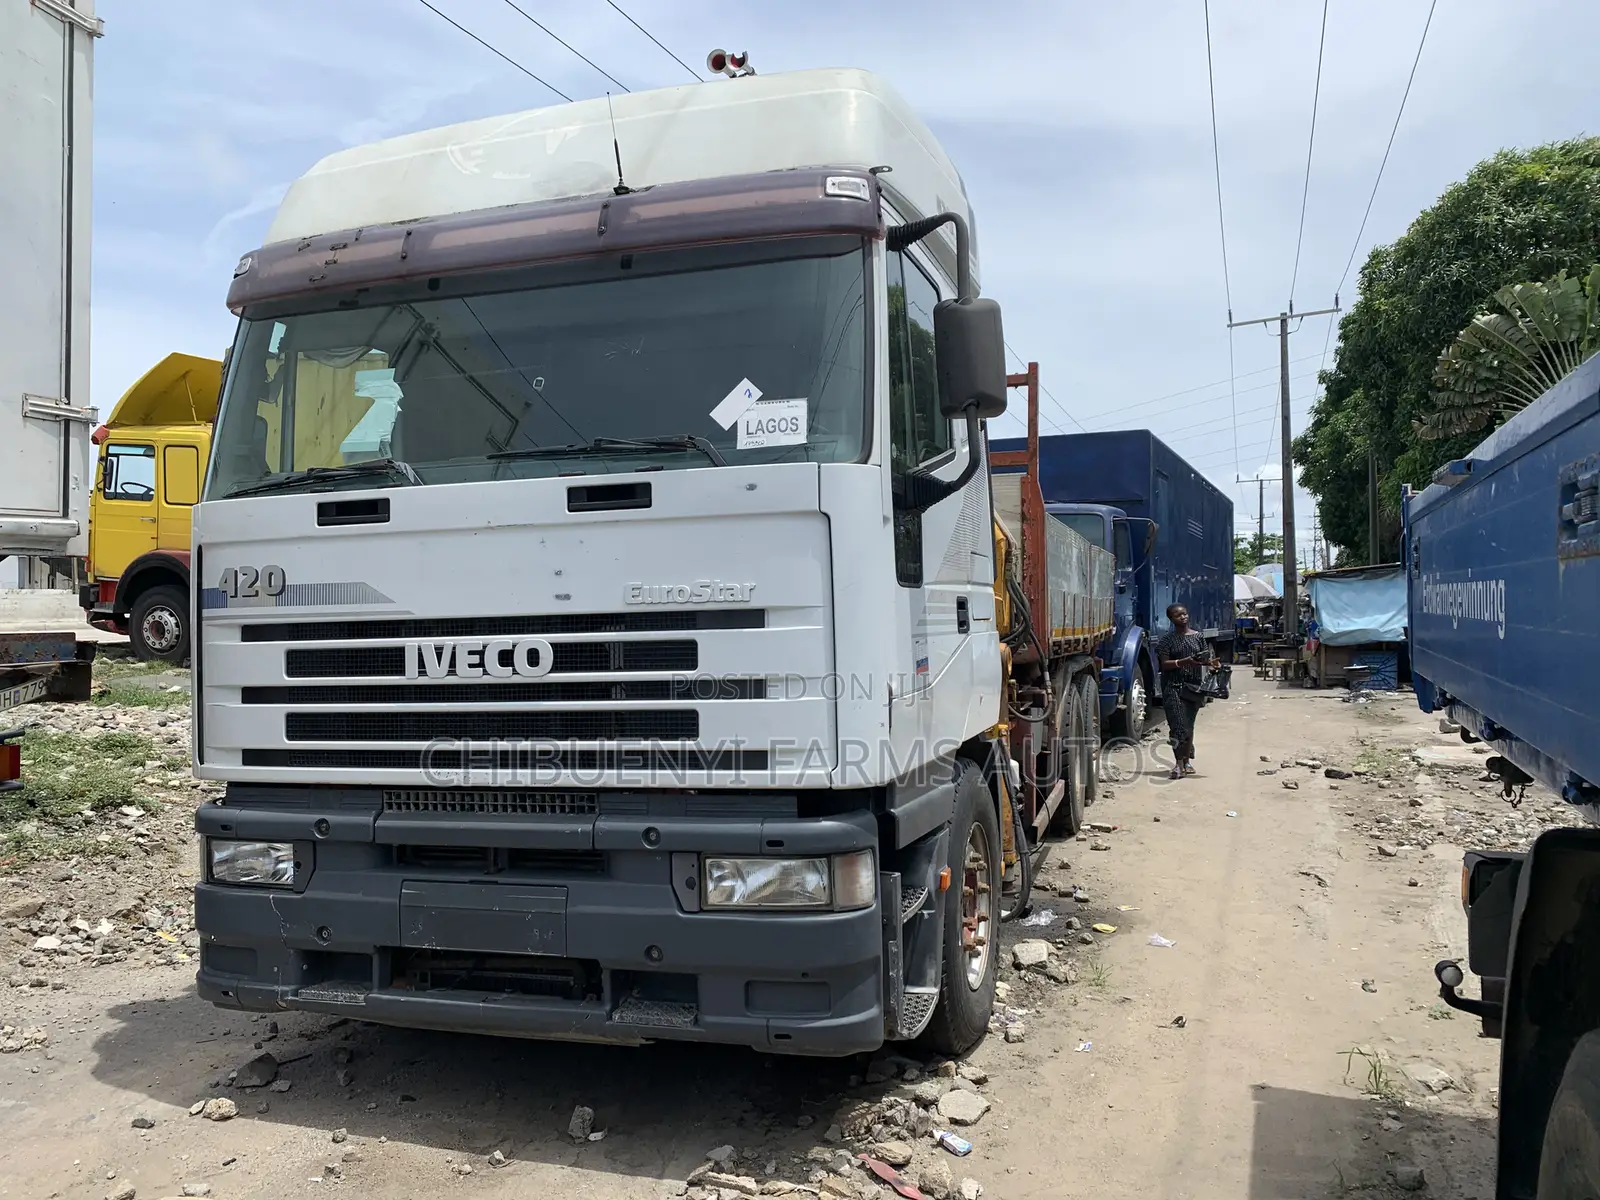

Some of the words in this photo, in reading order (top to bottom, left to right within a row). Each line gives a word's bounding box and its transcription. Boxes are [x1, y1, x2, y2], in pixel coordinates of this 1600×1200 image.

[746, 417, 799, 435] LAGOS
[219, 565, 286, 598] 420
[624, 579, 756, 604] EuroStar
[404, 638, 554, 680] IVECO
